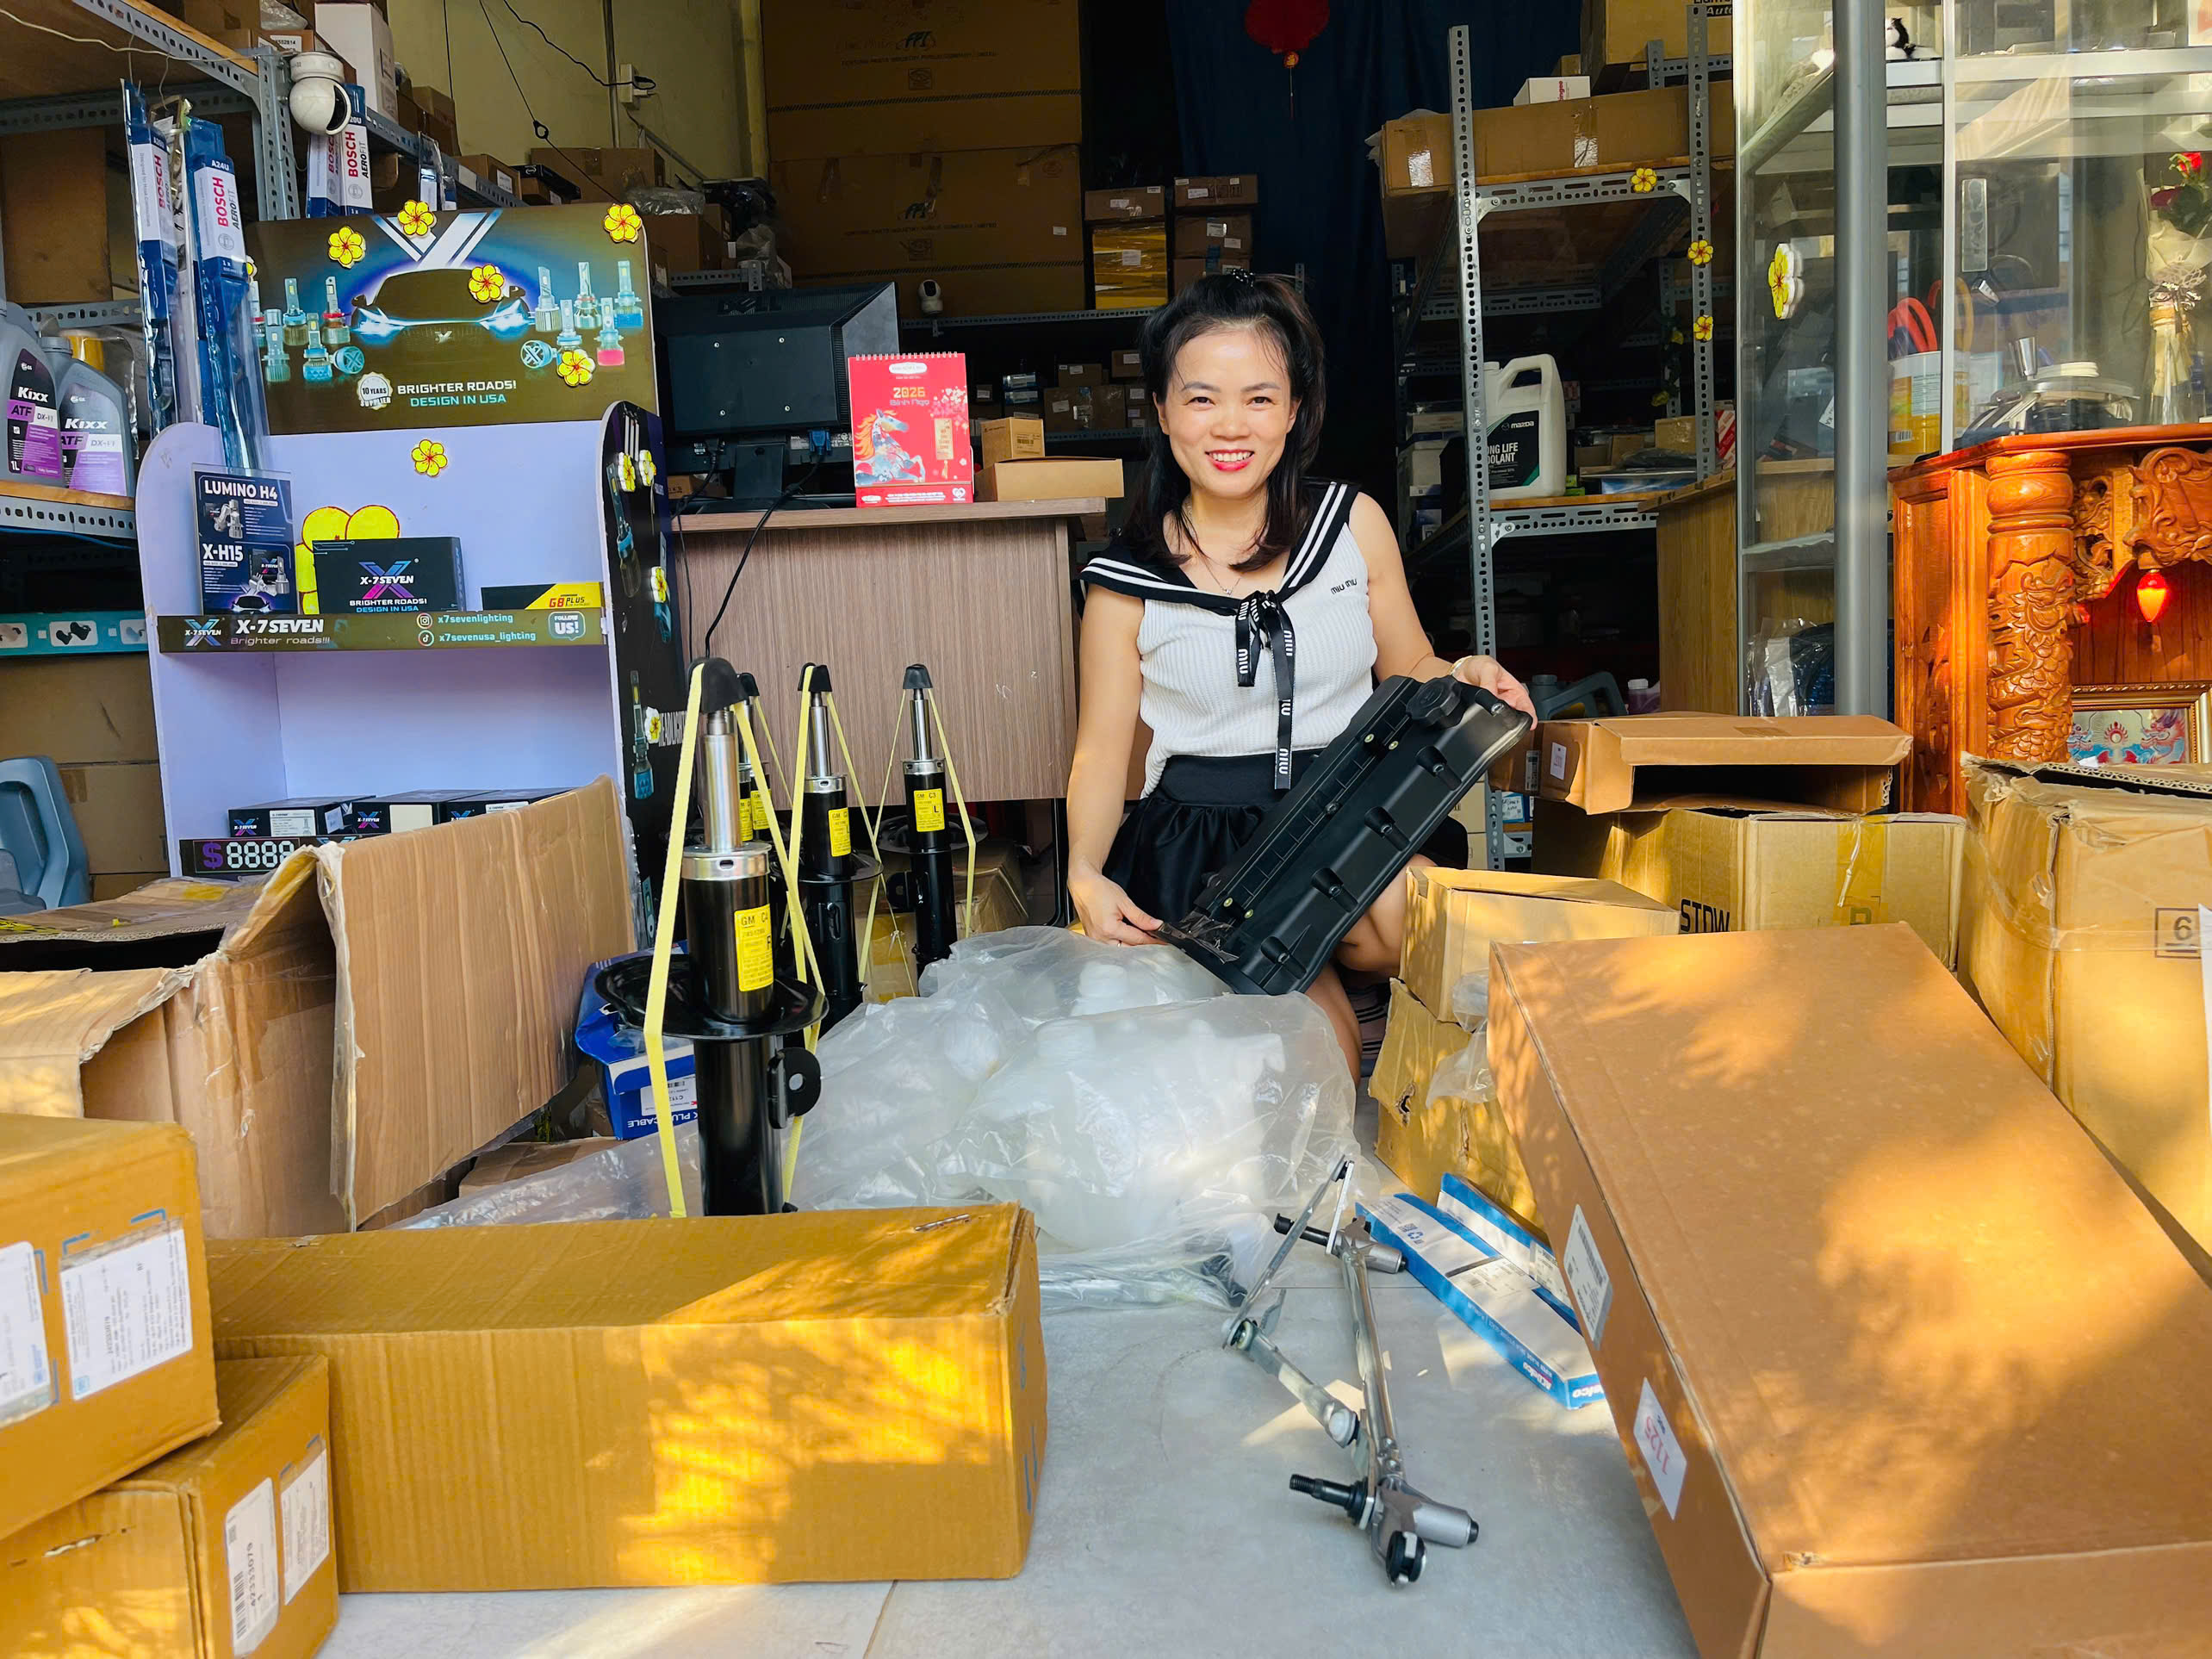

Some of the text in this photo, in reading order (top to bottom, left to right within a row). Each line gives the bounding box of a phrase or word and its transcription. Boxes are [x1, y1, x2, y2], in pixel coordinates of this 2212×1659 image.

[345, 131, 359, 178] BOSCH
[361, 141, 370, 179] AEROFIT
[153, 153, 166, 209] BOSCH
[212, 176, 229, 228] BOSCH
[231, 188, 241, 231] AEROFIT
[362, 387, 387, 395] 10 YEARS
[397, 380, 517, 395] BRIGHTER ROADS!
[892, 386, 926, 399] 2026
[17, 386, 49, 403] Kixx
[410, 394, 506, 407] DESIGN IN USA
[360, 396, 391, 407] SUPPLIER
[11, 405, 33, 417] ATF
[65, 418, 109, 430] Kixx
[1510, 420, 1535, 429] mazda
[60, 435, 84, 445] ATF
[1487, 442, 1519, 456] NG LIFE
[1488, 451, 1516, 465] OLANT
[204, 479, 278, 500] LUMINO H4
[202, 544, 244, 562] X-H15
[359, 575, 414, 585] X-7SEVEN
[549, 597, 565, 608] G8
[566, 596, 586, 605] PLUS
[438, 613, 513, 624] x7sevenlighting
[235, 618, 325, 634] X-7SEVEN
[554, 622, 580, 635] US!
[230, 636, 331, 647] Brighter roads!!!
[438, 631, 537, 643] x7sevenusa_lighting
[2173, 916, 2193, 941] 6
[672, 1112, 691, 1122] PLU
